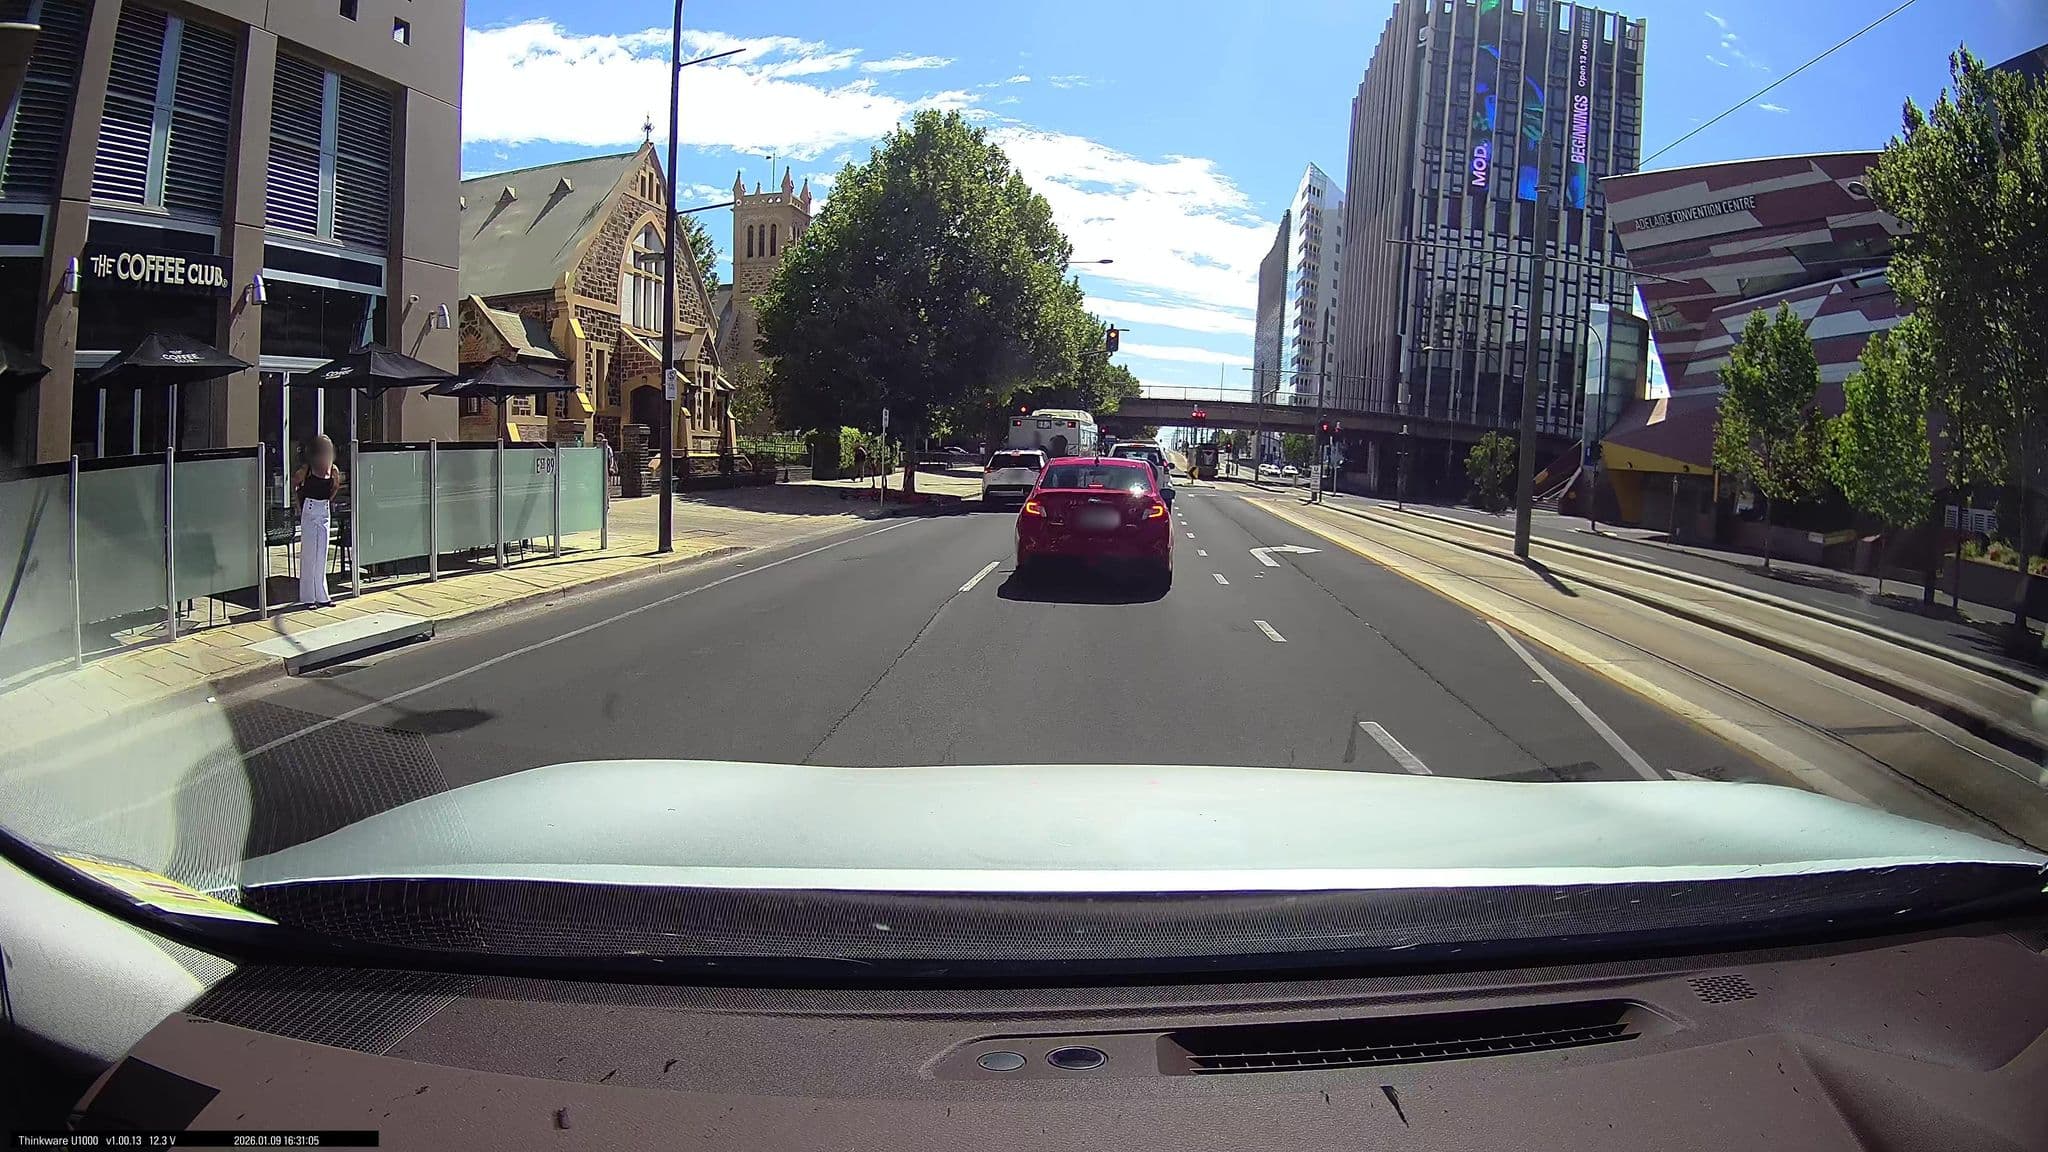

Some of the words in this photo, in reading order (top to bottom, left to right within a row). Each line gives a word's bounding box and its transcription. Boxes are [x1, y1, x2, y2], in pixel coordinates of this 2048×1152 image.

[1580, 39, 1588, 54] Jan
[1580, 55, 1587, 64] 13
[1578, 65, 1587, 87] Open
[1571, 94, 1588, 164] BEGINNINGS
[1472, 142, 1488, 186] MOD.
[1635, 213, 1672, 231] ADELAIDE
[1671, 202, 1722, 223] CONVENTION
[1722, 196, 1756, 214] CENTRE
[90, 254, 116, 277] THE
[116, 252, 186, 285] COFFEE
[546, 457, 555, 474] 89
